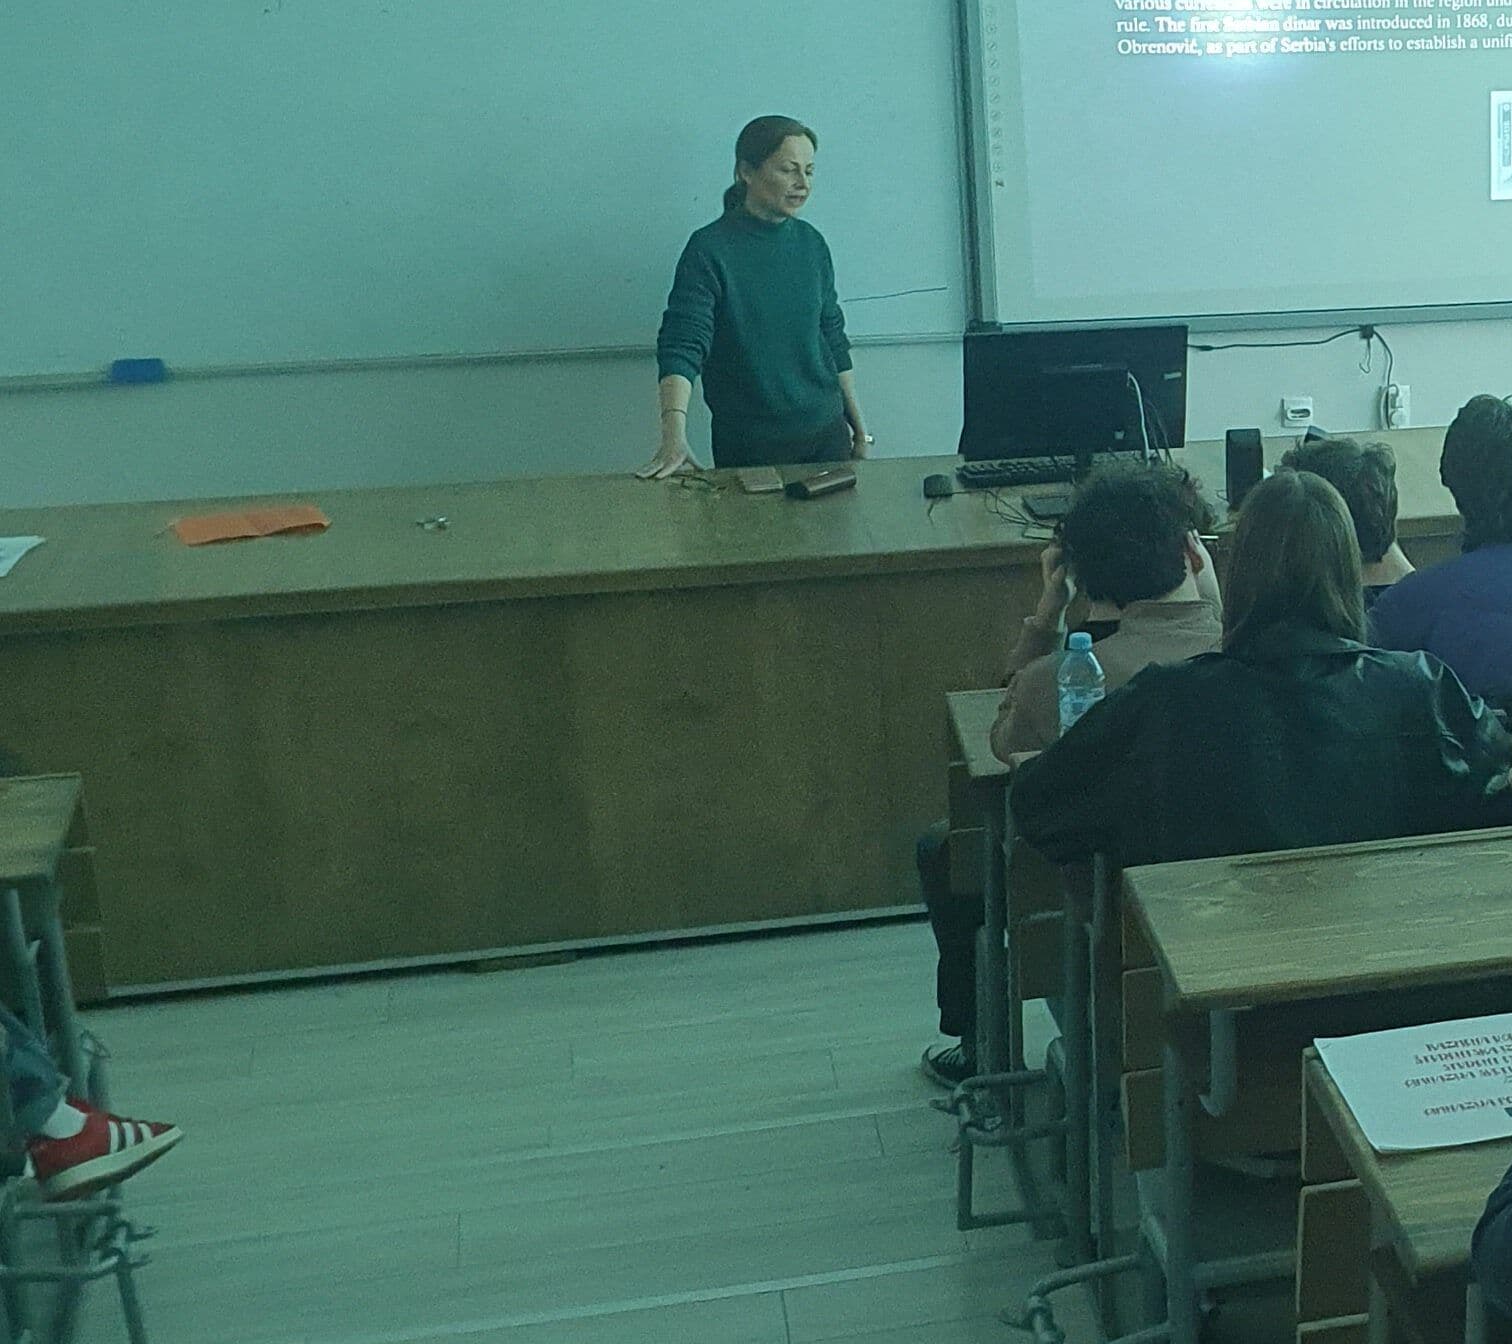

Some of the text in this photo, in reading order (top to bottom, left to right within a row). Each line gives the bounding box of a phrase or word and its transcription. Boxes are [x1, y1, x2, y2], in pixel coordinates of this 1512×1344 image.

[1116, 17, 1150, 32] rule.
[1155, 17, 1185, 32] The
[1190, 17, 1220, 32] first
[1283, 16, 1321, 31] dinar
[1325, 19, 1353, 30] was
[1357, 15, 1432, 30] introduced
[1437, 15, 1450, 28] in
[1456, 13, 1493, 30] 1868,
[1118, 38, 1203, 56] Obrenović,
[1206, 42, 1223, 54] as
[1226, 40, 1257, 57] part
[1260, 38, 1278, 54] of
[1281, 36, 1336, 53] Serbia's
[1340, 36, 1385, 51] efforts
[1389, 38, 1403, 51] to
[1407, 34, 1466, 50] establish
[1470, 38, 1478, 49] a
